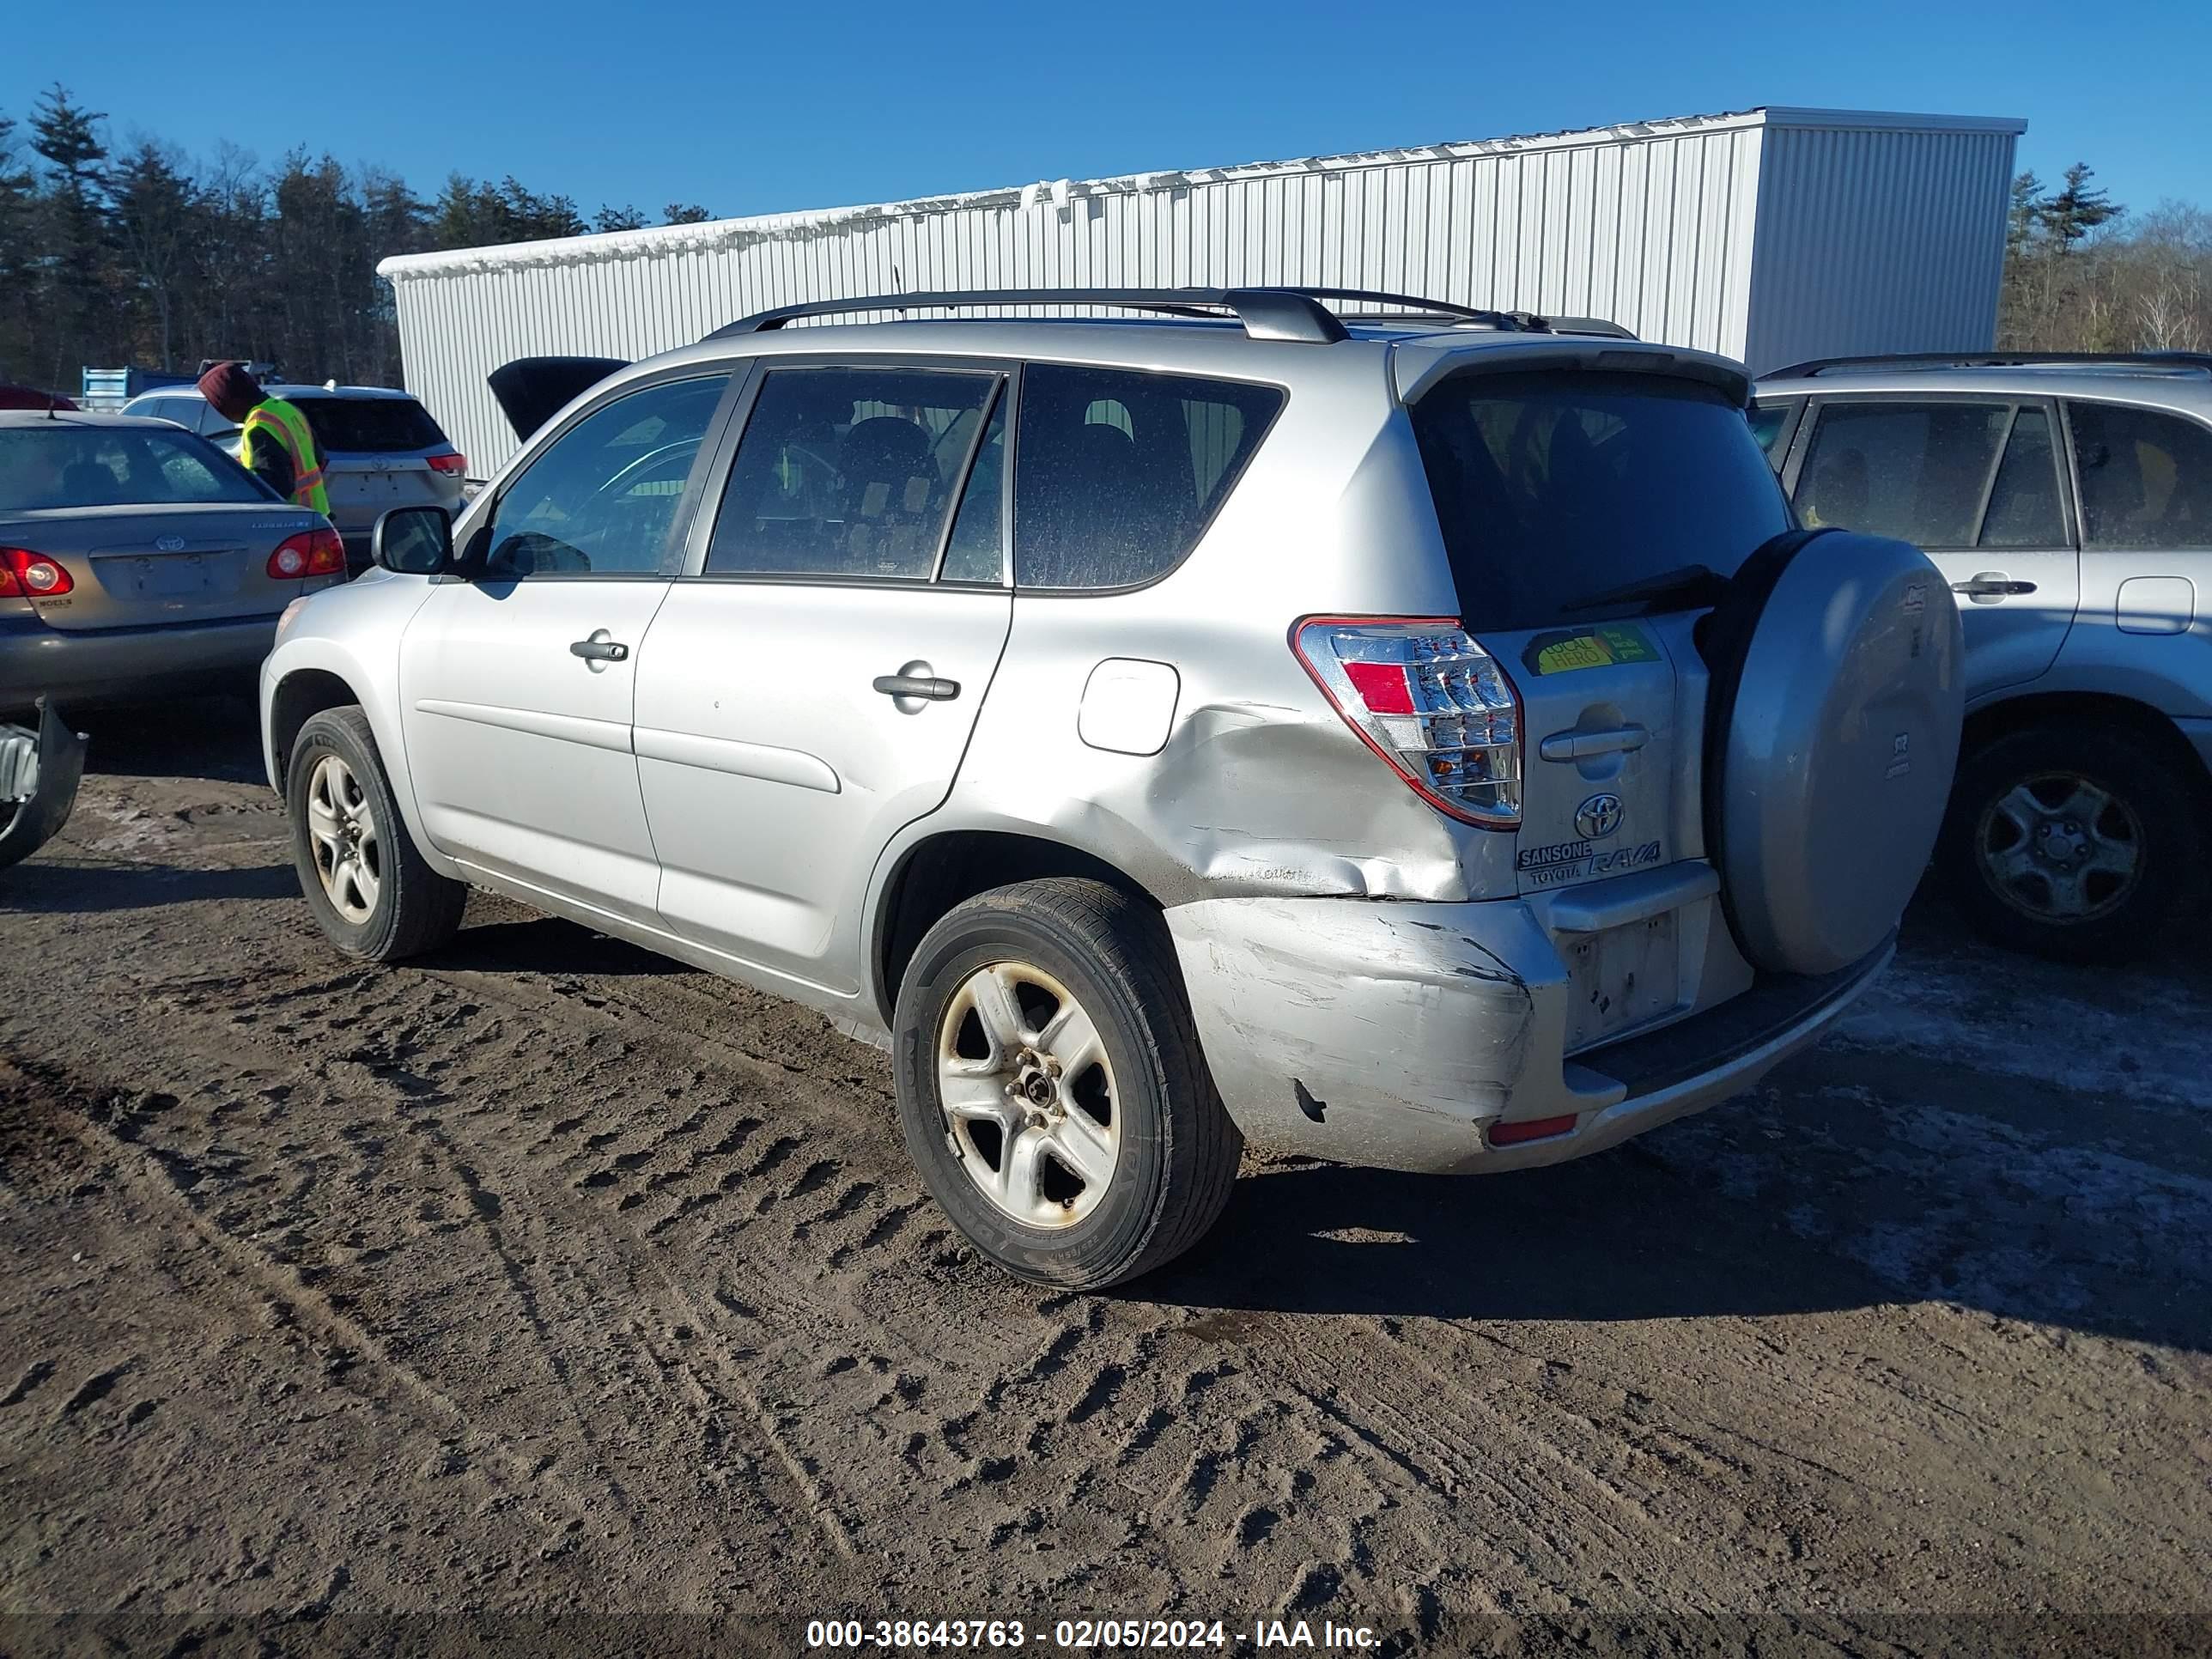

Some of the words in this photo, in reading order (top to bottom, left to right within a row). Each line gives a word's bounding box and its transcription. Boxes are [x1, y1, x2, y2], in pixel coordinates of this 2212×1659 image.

[1545, 638, 1593, 655] LOCAL
[1550, 650, 1600, 668] HERO
[1518, 841, 1592, 866] SANSONE
[1589, 841, 1661, 875] RAV4
[1532, 865, 1581, 884] TOYOTA
